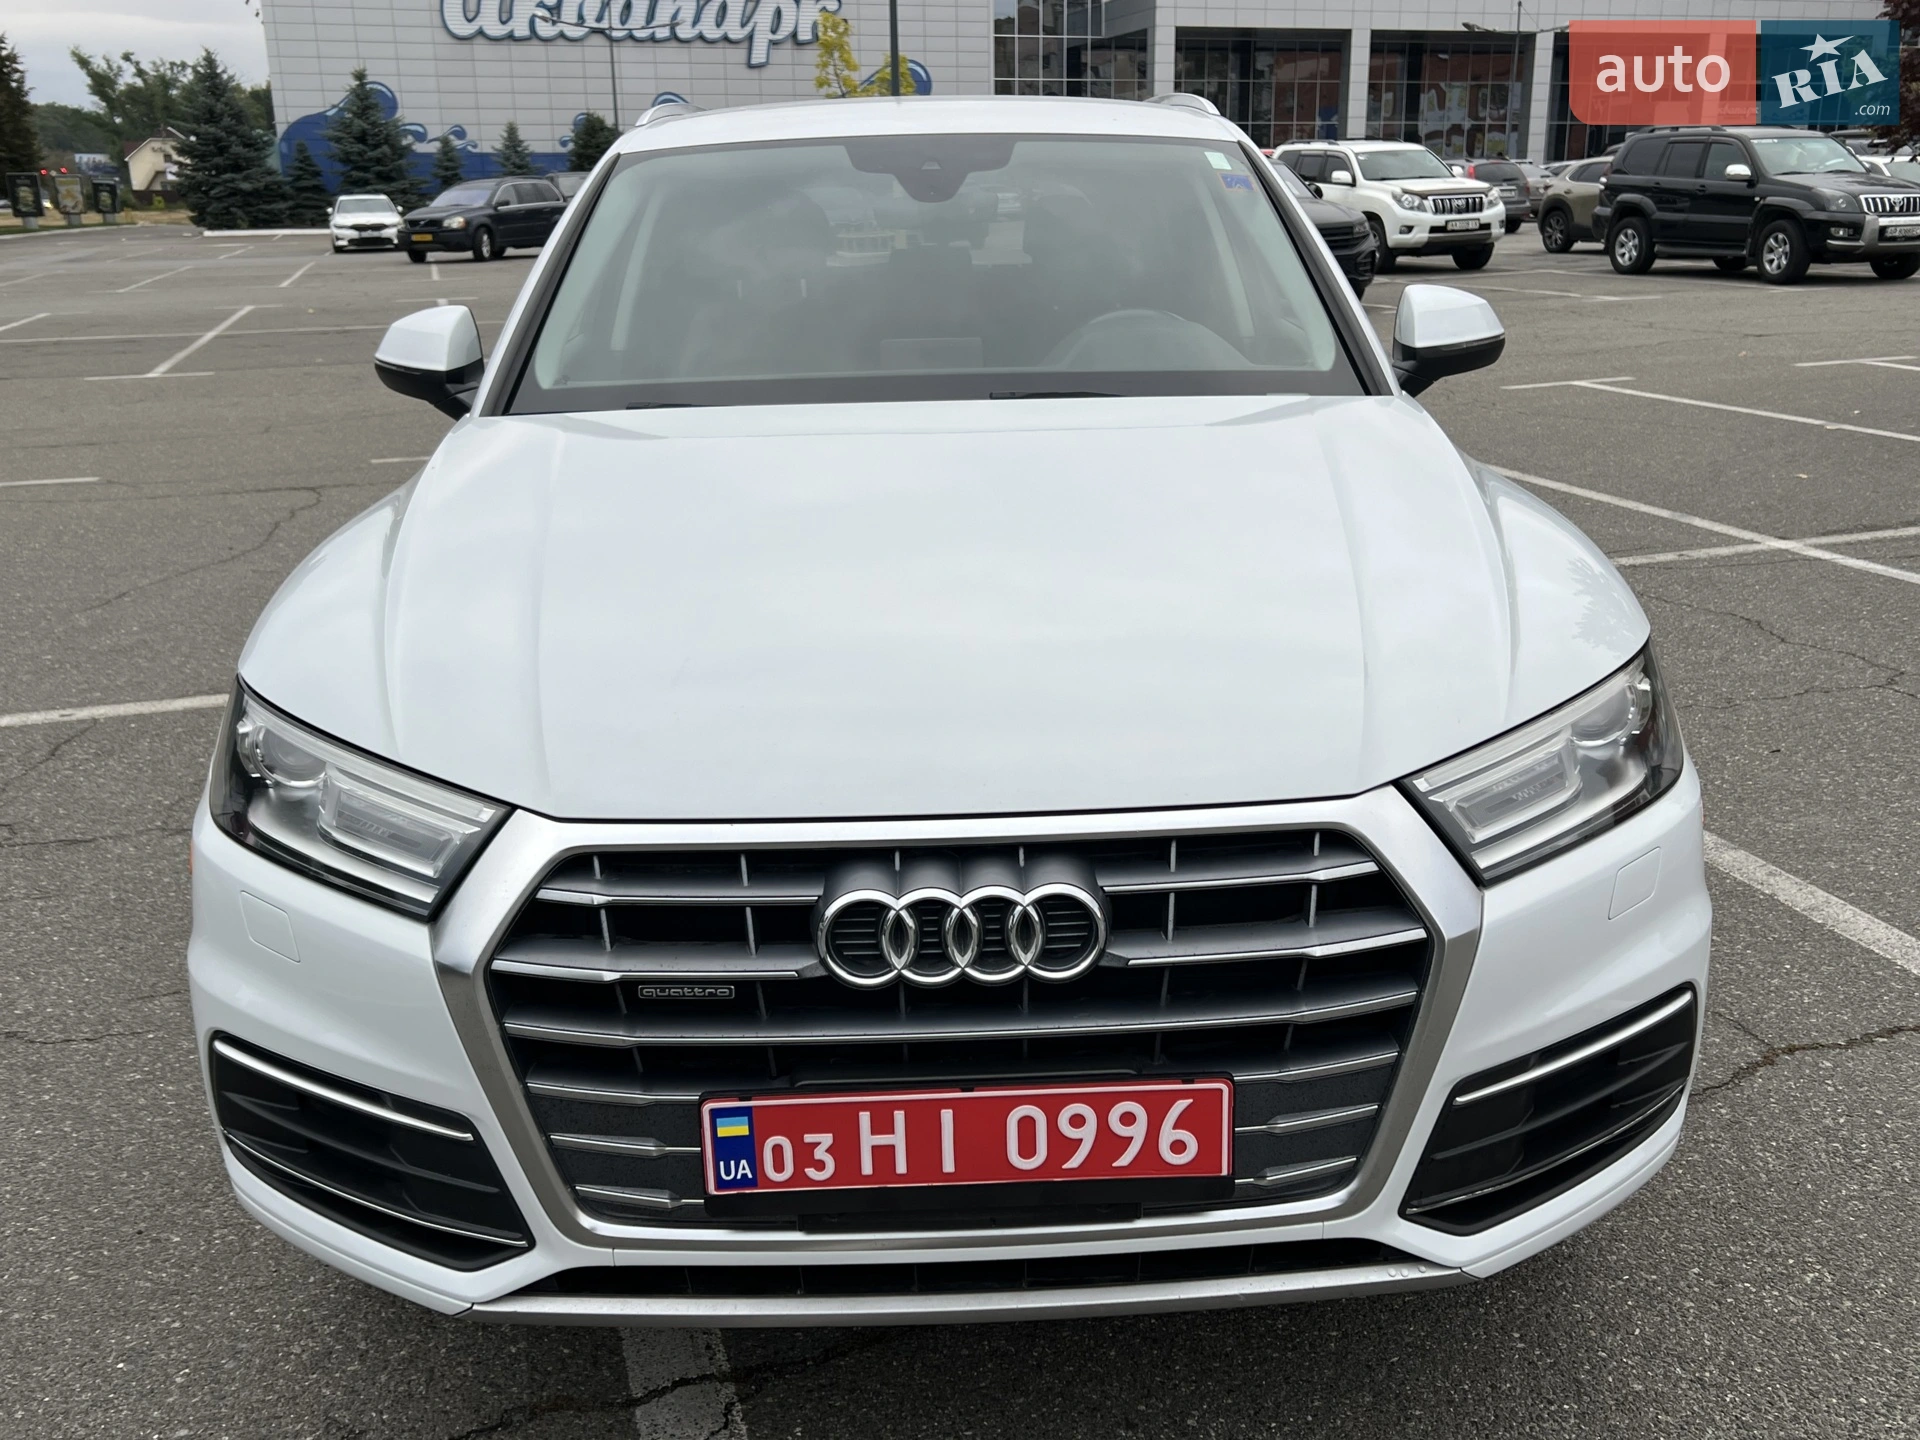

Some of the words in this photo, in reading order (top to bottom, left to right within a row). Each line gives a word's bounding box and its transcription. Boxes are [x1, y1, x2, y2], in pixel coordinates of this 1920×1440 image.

[642, 987, 730, 998] quattro
[762, 1133, 836, 1182] 03
[1006, 1099, 1200, 1171] 0996
[719, 1158, 753, 1182] UA
